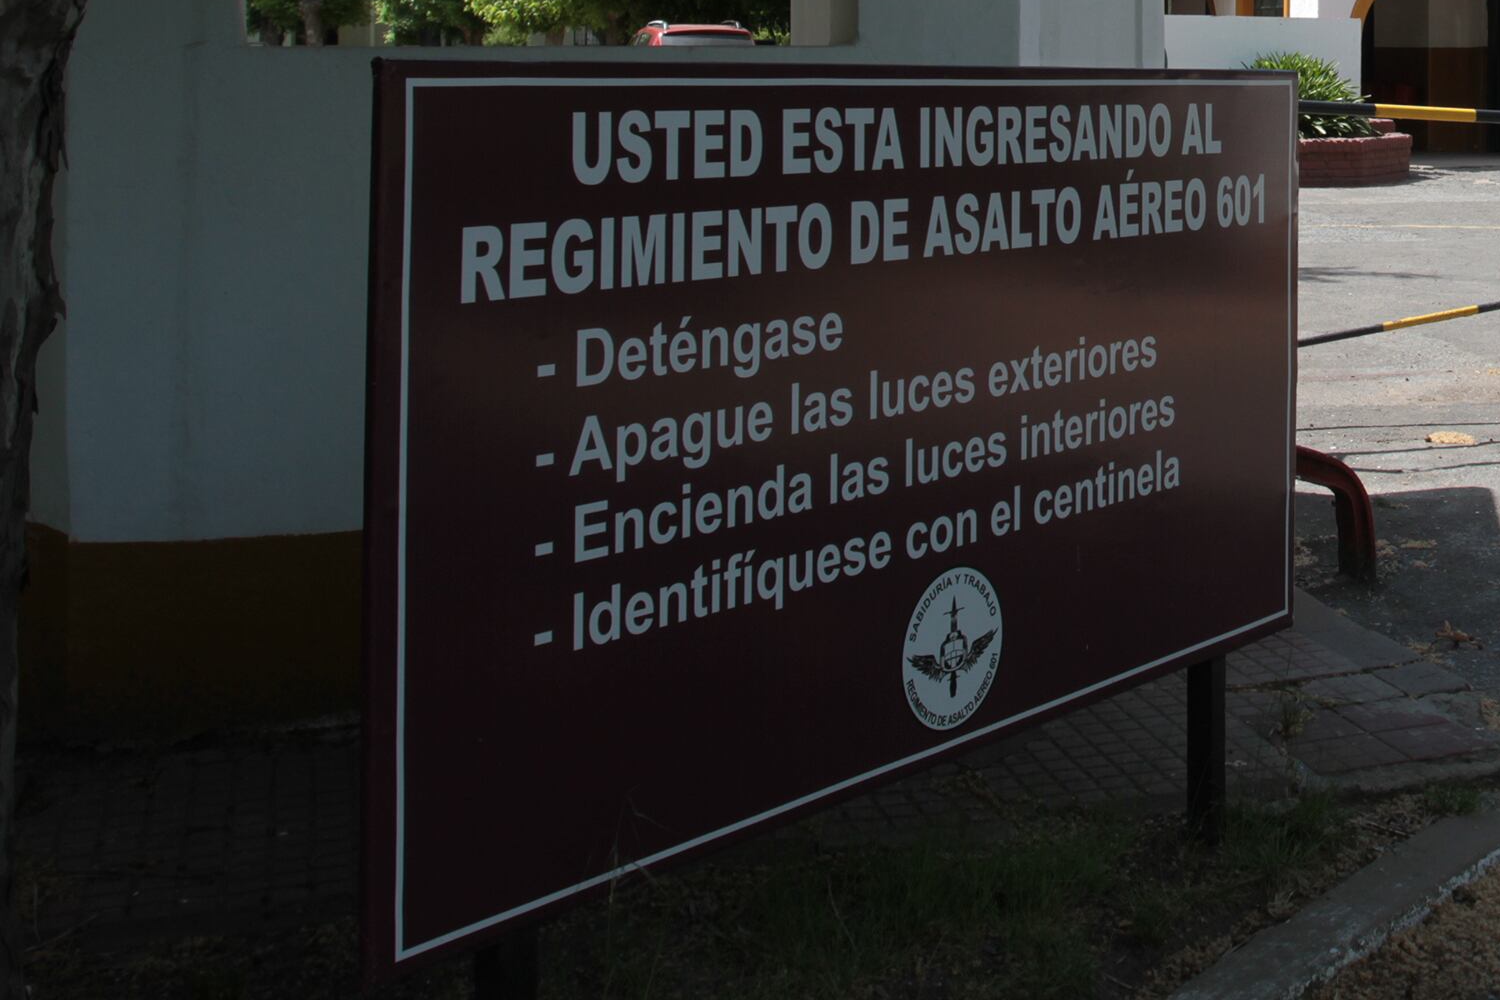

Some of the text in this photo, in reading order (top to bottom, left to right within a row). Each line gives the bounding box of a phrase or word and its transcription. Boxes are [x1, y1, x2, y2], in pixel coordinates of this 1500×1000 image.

[572, 102, 1222, 186] USTED ESTA INGRESANDO AL
[460, 169, 1266, 305] REGIMIENTO DE ASALTO AÉREO 601
[575, 312, 843, 388] Deténgase
[568, 401, 774, 483] Apague
[791, 382, 853, 435] las
[869, 367, 976, 420] luces
[988, 335, 1157, 398] exteriores
[574, 463, 813, 564] Encienda
[829, 452, 890, 505] las
[905, 431, 1007, 488] luces
[1020, 394, 1175, 461] interiores
[573, 531, 892, 652] Identifíquese
[905, 508, 978, 560] con
[990, 484, 1021, 537] el
[1033, 449, 1180, 525] centinela
[909, 573, 996, 642] SABIDURÍA Y TRABAJO
[906, 679, 937, 726] REGIMIENTO
[937, 714, 947, 727] DE
[948, 701, 974, 726] ASALTO
[990, 652, 998, 670] 601
